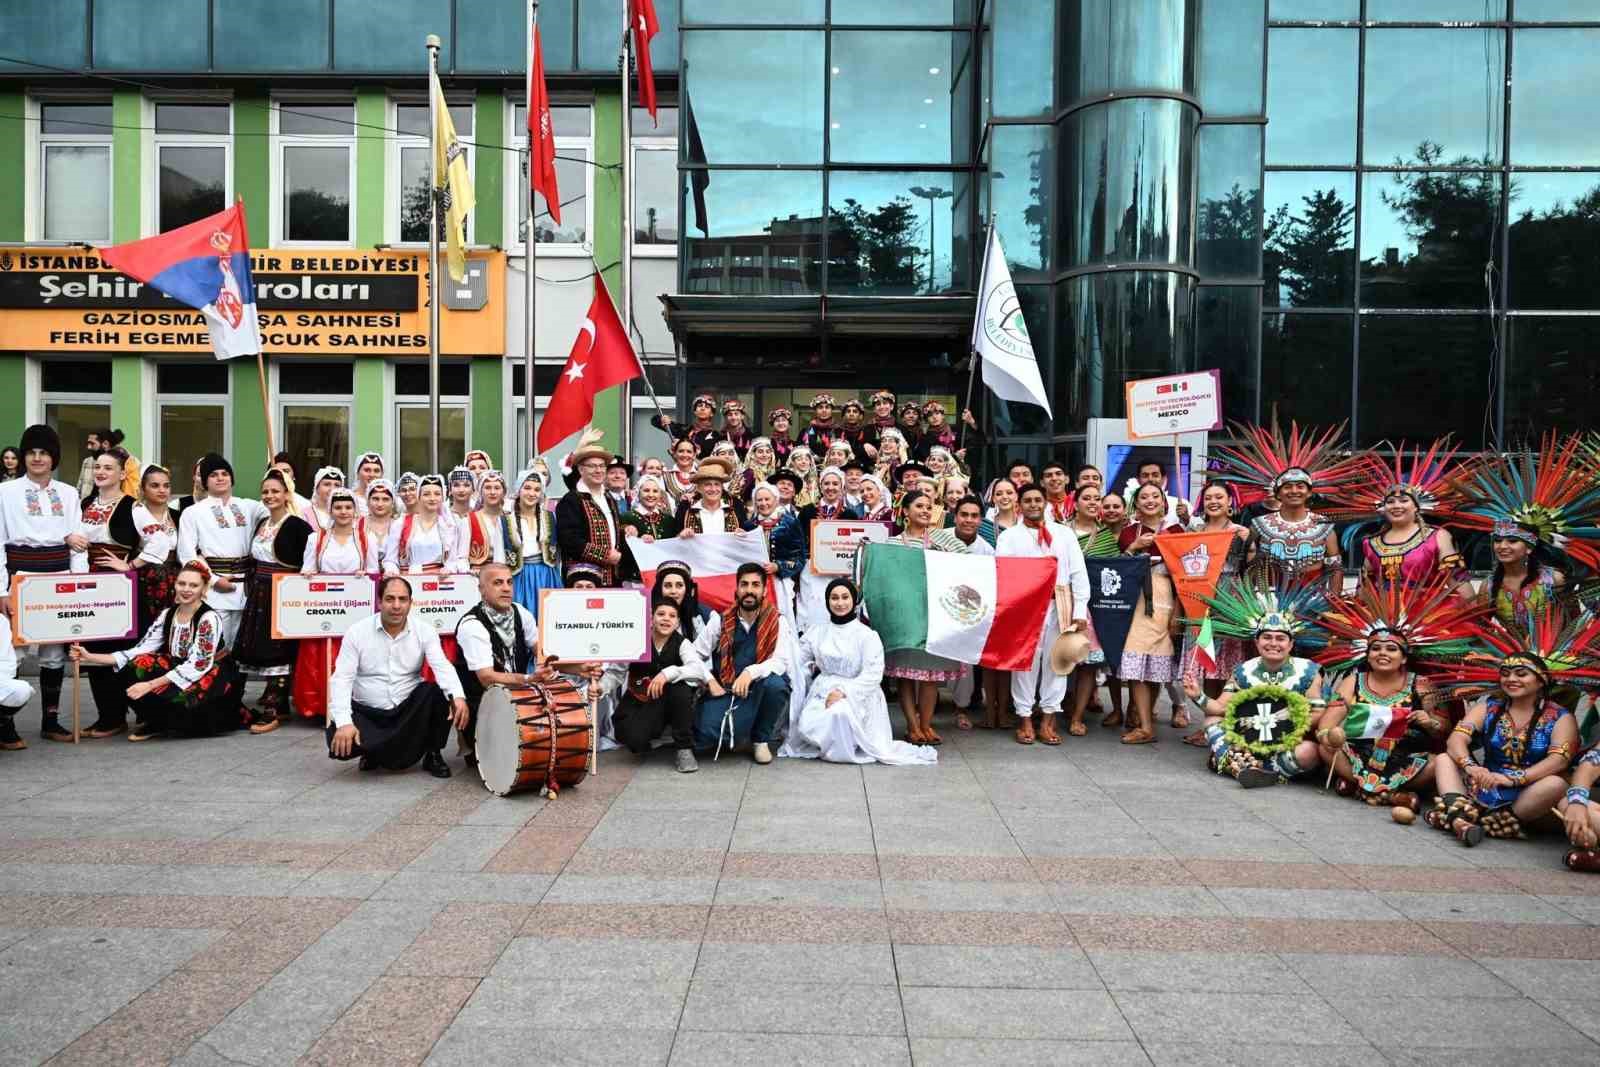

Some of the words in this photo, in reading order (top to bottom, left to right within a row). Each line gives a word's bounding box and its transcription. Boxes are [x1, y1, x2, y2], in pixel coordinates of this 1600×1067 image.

[291, 255, 418, 272] BELEDİYESİ
[39, 274, 144, 304] Şehir
[252, 275, 370, 300] roları
[296, 313, 401, 328] SAHNESİ
[50, 329, 119, 345] FERİH
[1158, 409, 1189, 418] MEXICO
[57, 610, 95, 619] SERBIA
[420, 606, 457, 614] CROATIA
[555, 620, 594, 630] İSTANBUL
[601, 620, 635, 629] TÜRKİYE
